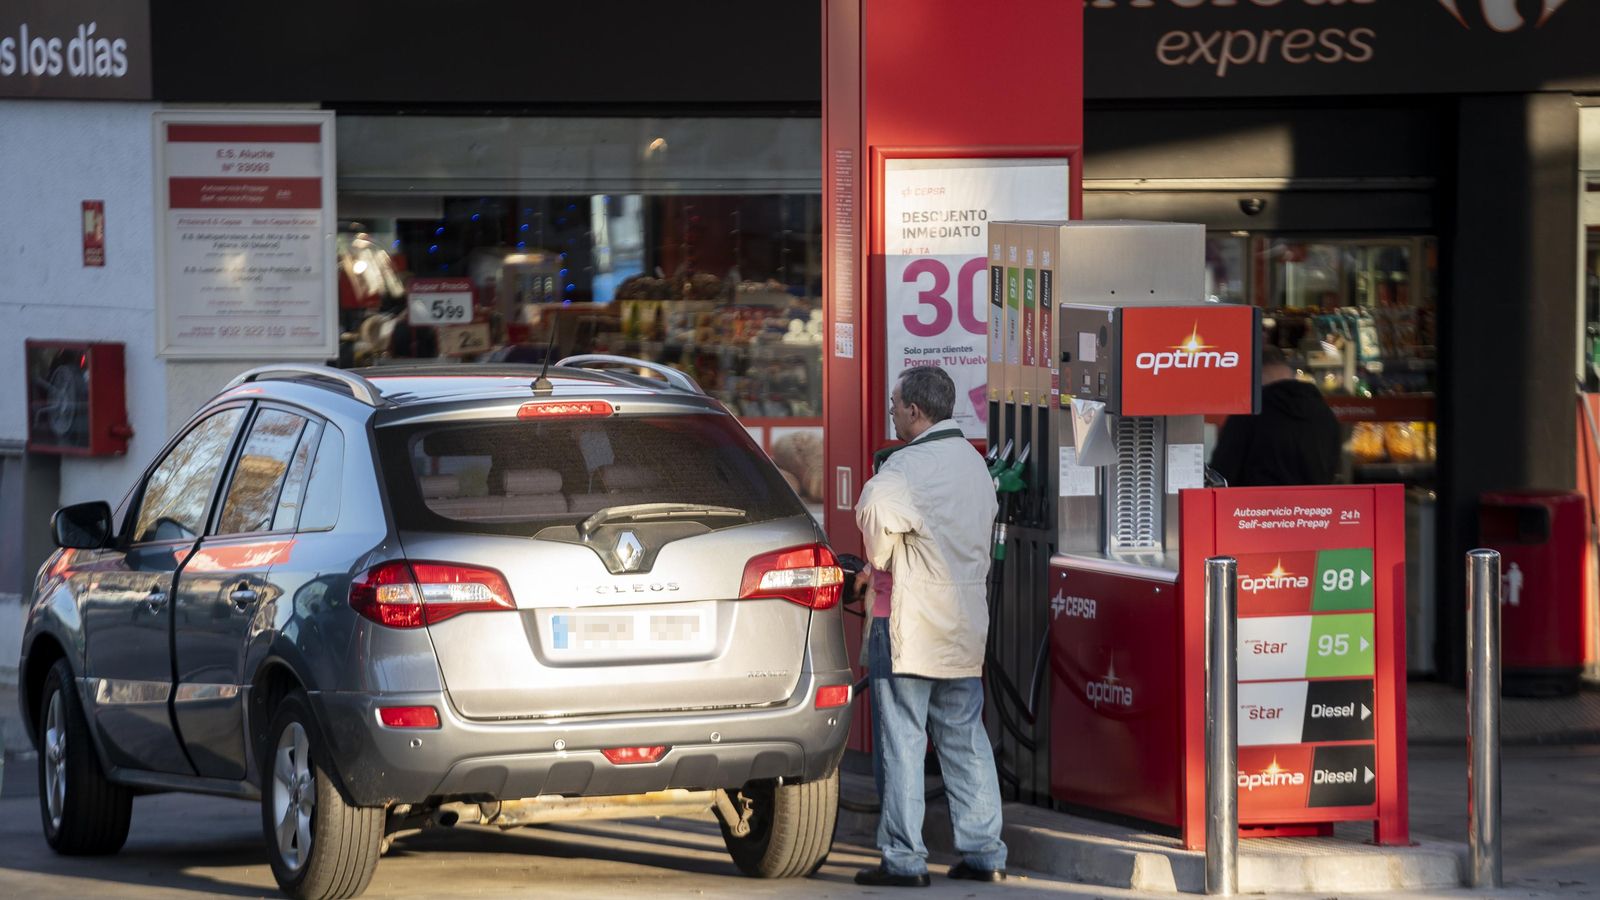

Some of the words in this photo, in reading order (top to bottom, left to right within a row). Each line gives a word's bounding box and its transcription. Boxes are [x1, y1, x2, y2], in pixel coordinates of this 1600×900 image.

[20, 23, 62, 77] los
[67, 21, 129, 78] días
[1155, 26, 1377, 78] express
[901, 209, 988, 224] DESCUENTO
[901, 225, 981, 239] INMEDIATO
[903, 346, 922, 355] Solo
[923, 347, 941, 356] para
[942, 345, 974, 354] clientes
[903, 357, 941, 369] Porque
[942, 356, 957, 367] TU
[1135, 347, 1240, 376] optima
[1233, 506, 1292, 517] Autoservicio
[1293, 505, 1333, 516] Prepago
[1237, 519, 1295, 530] Self-service
[1296, 518, 1330, 530] Prepay
[1241, 573, 1310, 594] optima
[1322, 568, 1355, 592] 98
[1065, 595, 1097, 619] CEPSA
[1252, 640, 1288, 655] star
[1317, 633, 1350, 657] 95
[1086, 679, 1134, 709] optima
[1248, 705, 1284, 720] star
[1310, 702, 1355, 718] Diesel
[1237, 770, 1305, 792] optima
[1313, 767, 1358, 784] Diesel
